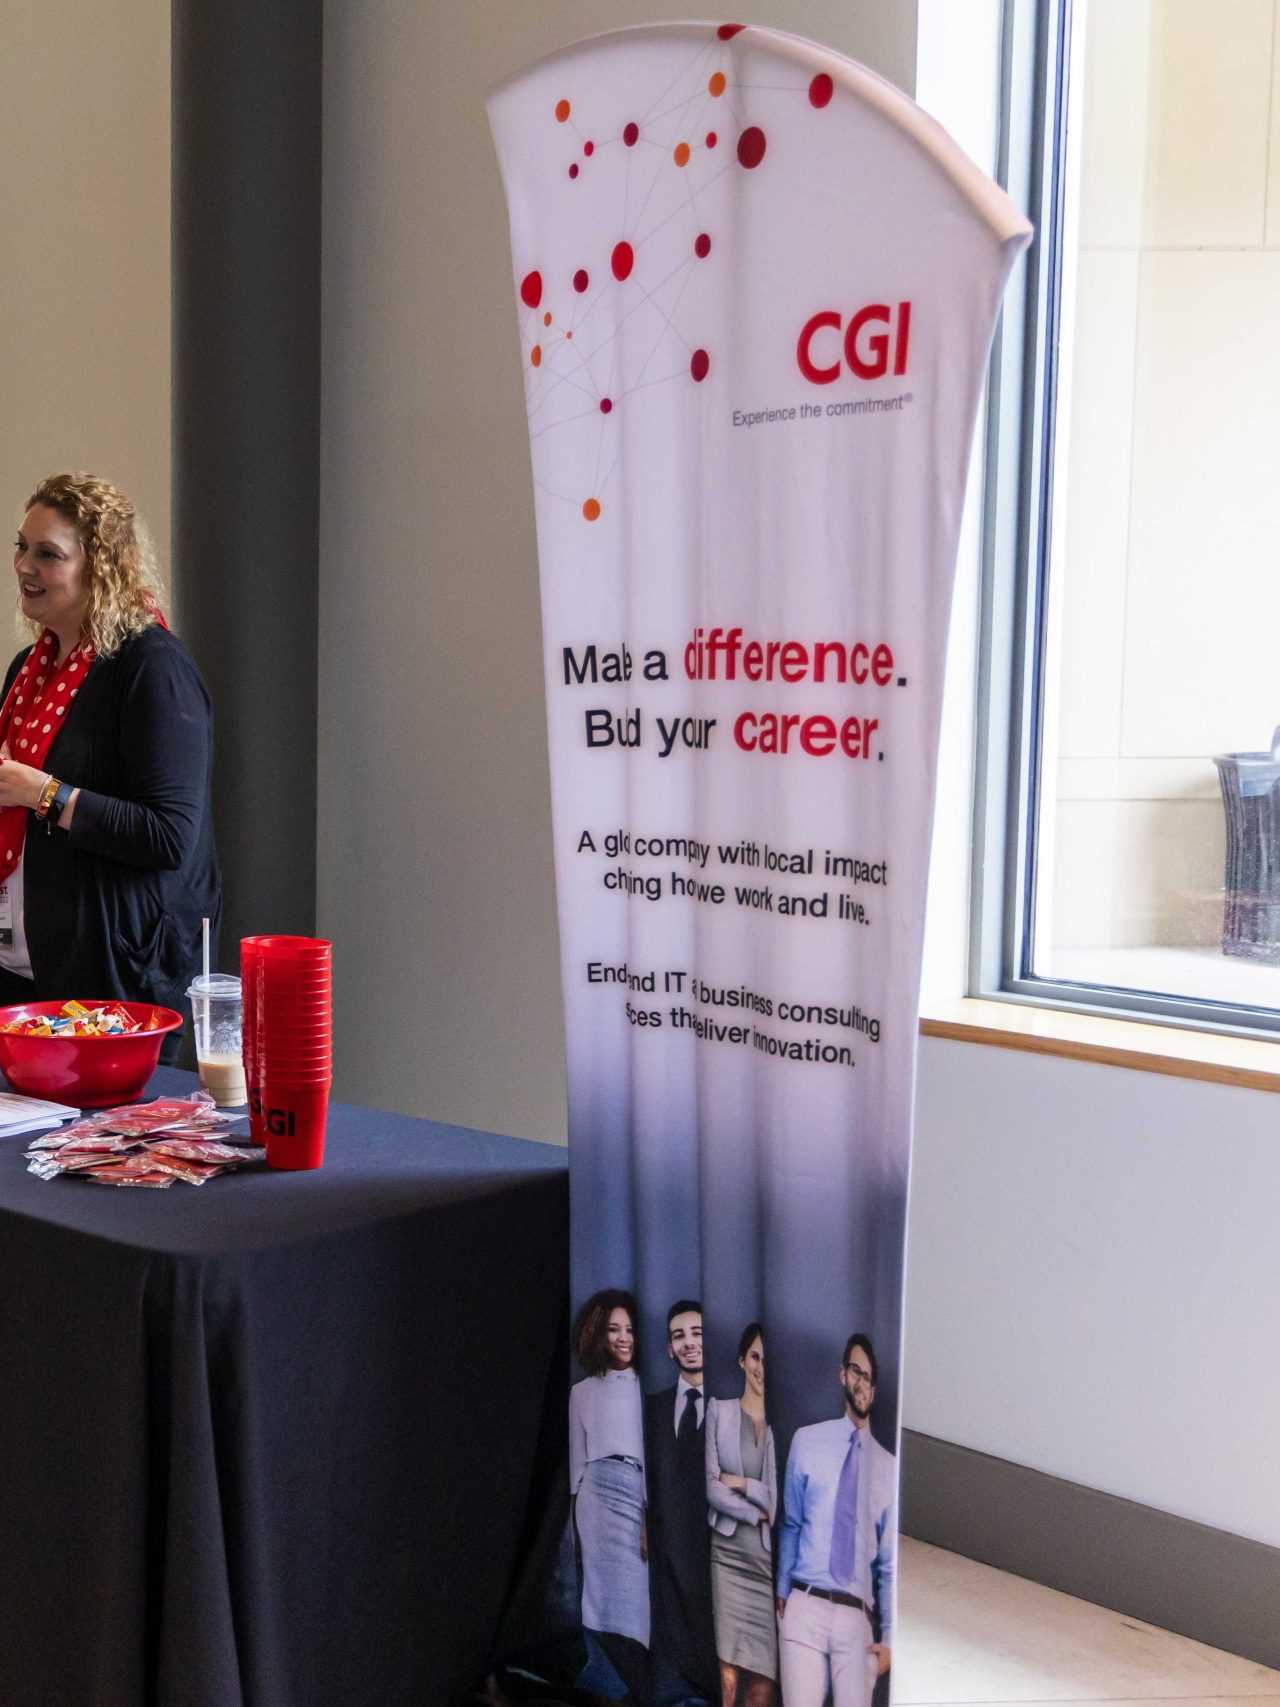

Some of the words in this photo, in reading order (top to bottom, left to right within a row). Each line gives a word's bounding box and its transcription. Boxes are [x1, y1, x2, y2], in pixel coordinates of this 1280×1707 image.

[797, 301, 911, 385] CGI
[732, 406, 796, 428] Experience
[800, 403, 822, 417] the
[643, 650, 669, 680] a
[684, 628, 907, 687] difference.
[734, 711, 884, 761] career.
[577, 830, 597, 853] A
[718, 841, 760, 867] with
[764, 844, 813, 875] local
[825, 850, 888, 886] impact
[735, 886, 773, 912] work
[778, 893, 828, 917] and
[839, 894, 870, 925] live.
[664, 971, 687, 993] IT
[699, 981, 773, 1017] business
[778, 1002, 881, 1043] consulting
[753, 1025, 856, 1067] innovation.
[267, 1108, 296, 1137] GI
